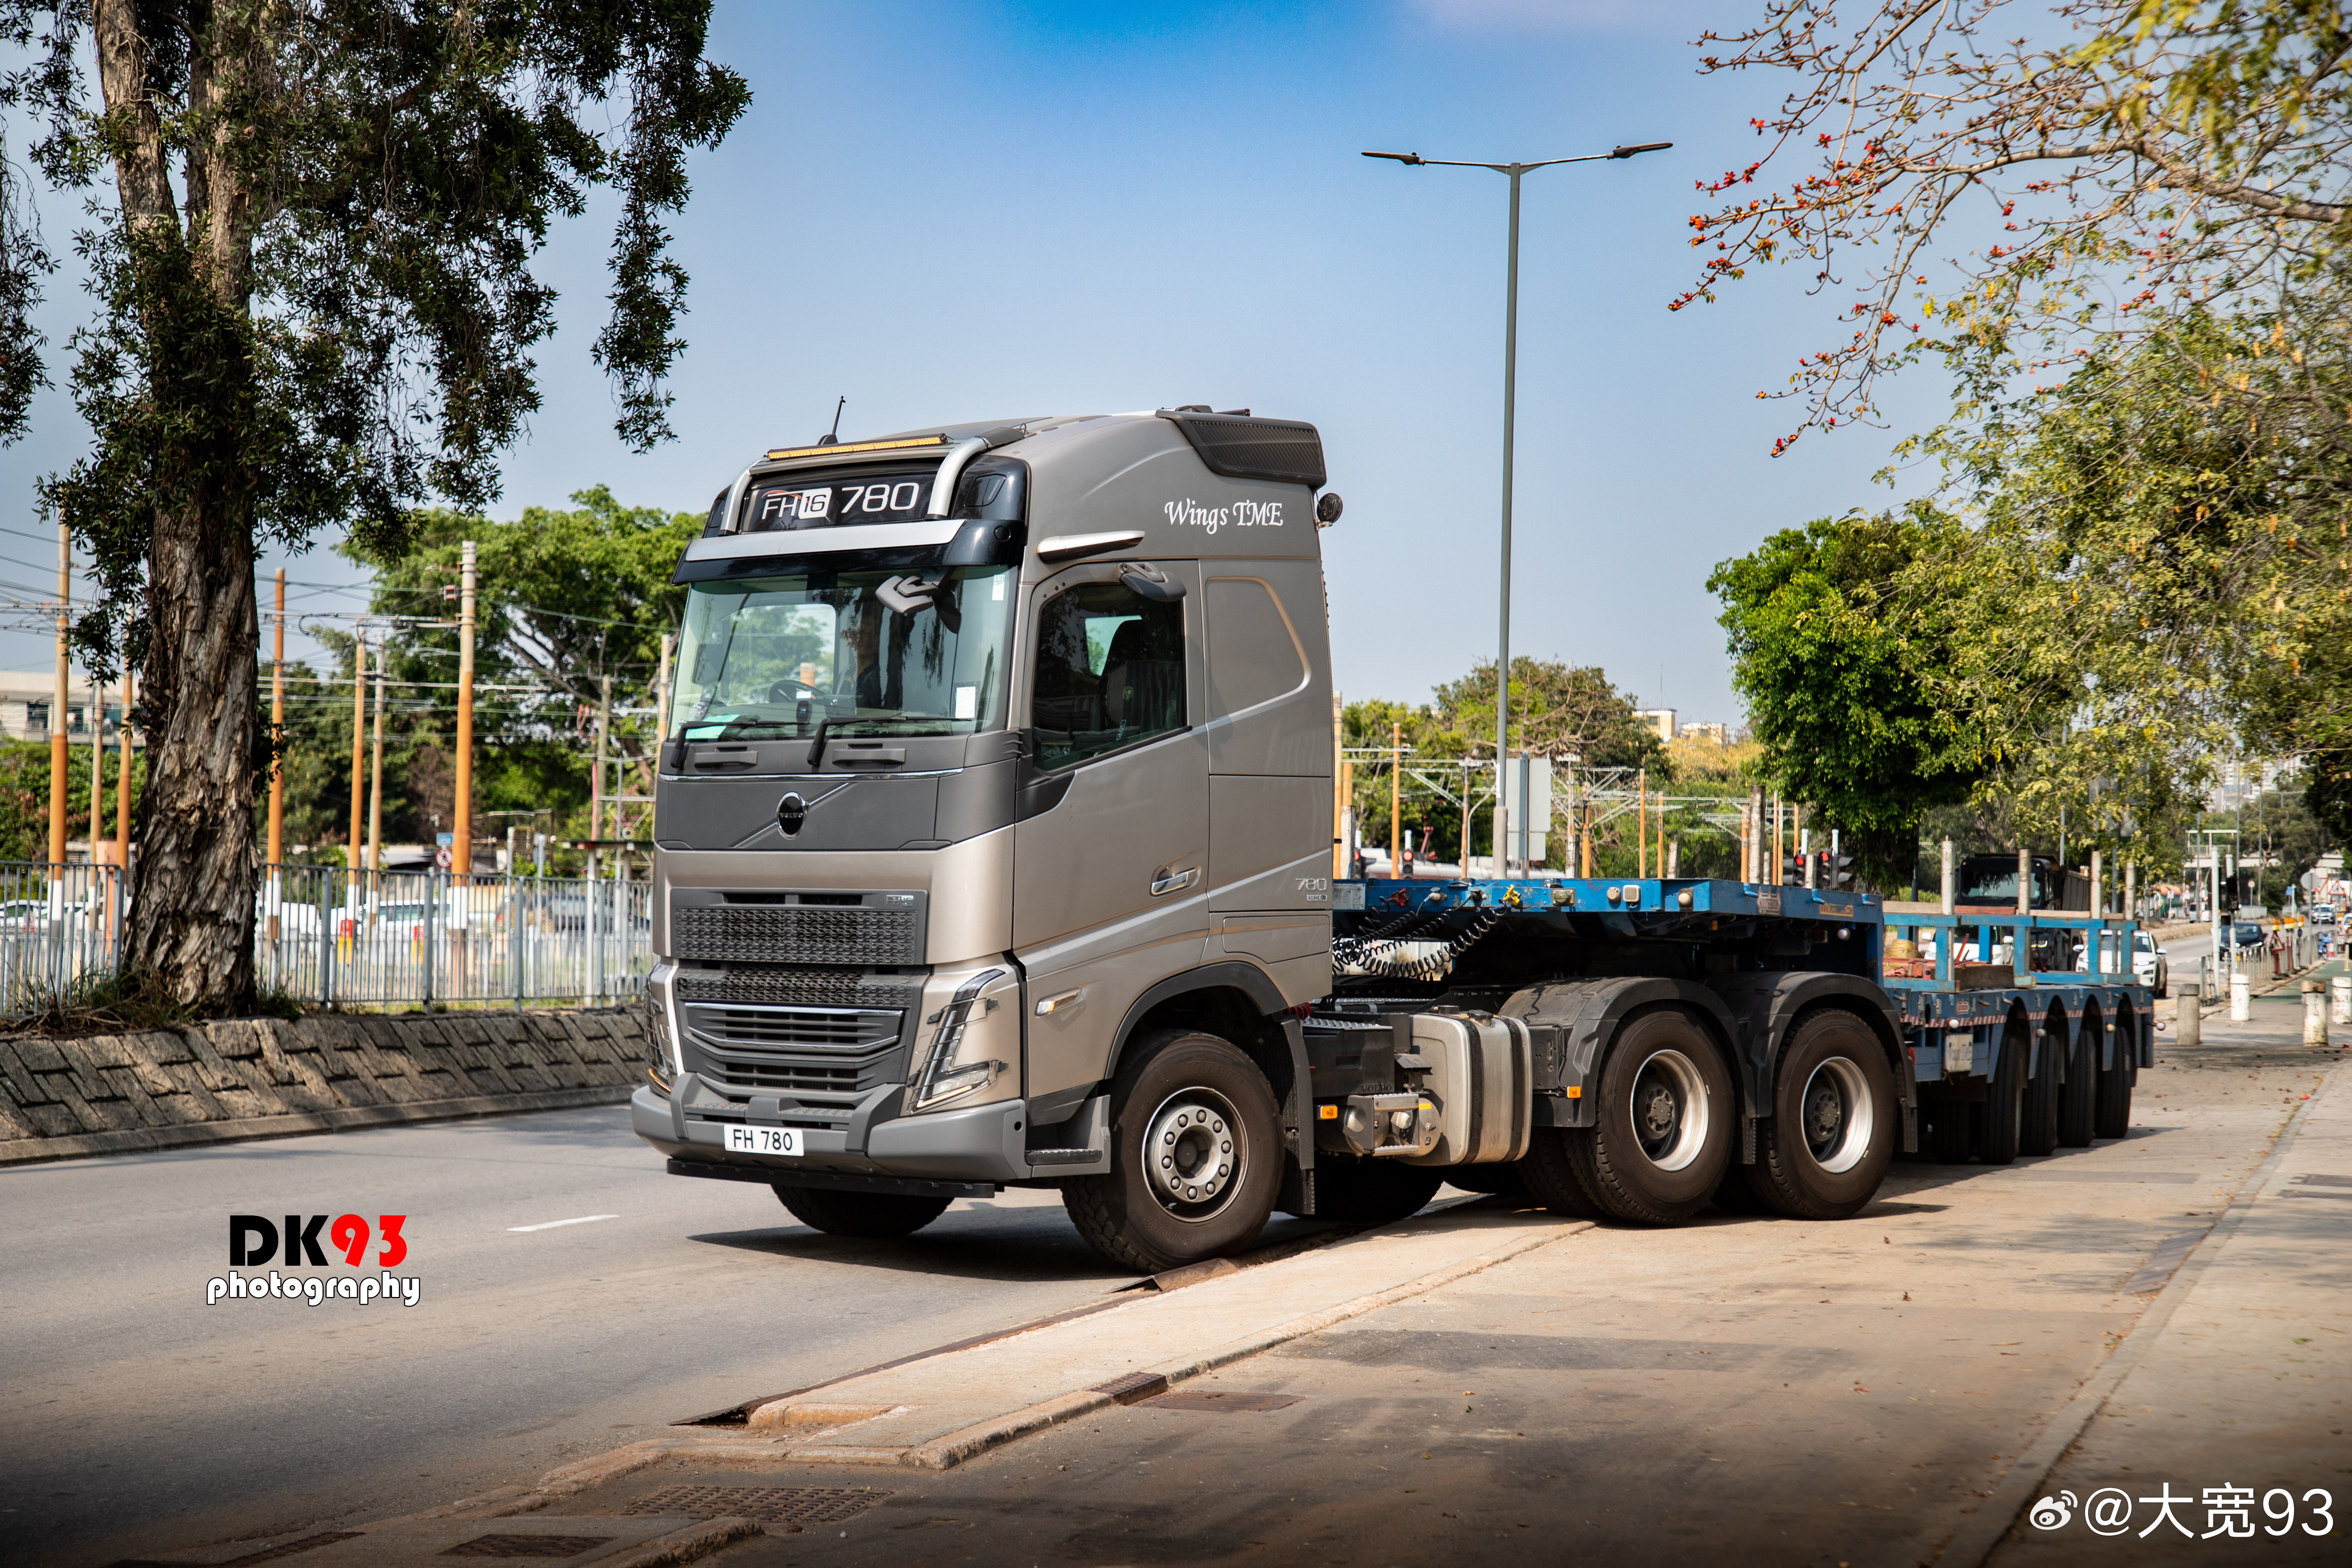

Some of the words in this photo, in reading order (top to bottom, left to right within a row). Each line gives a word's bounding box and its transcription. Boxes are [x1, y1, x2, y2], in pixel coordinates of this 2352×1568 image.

[841, 482, 920, 514] 780
[1164, 498, 1229, 534] Wings
[1295, 878, 1327, 891] 780
[1360, 1083, 1392, 1092] VOLVO
[733, 1129, 753, 1149] FH
[761, 1131, 792, 1151] 780
